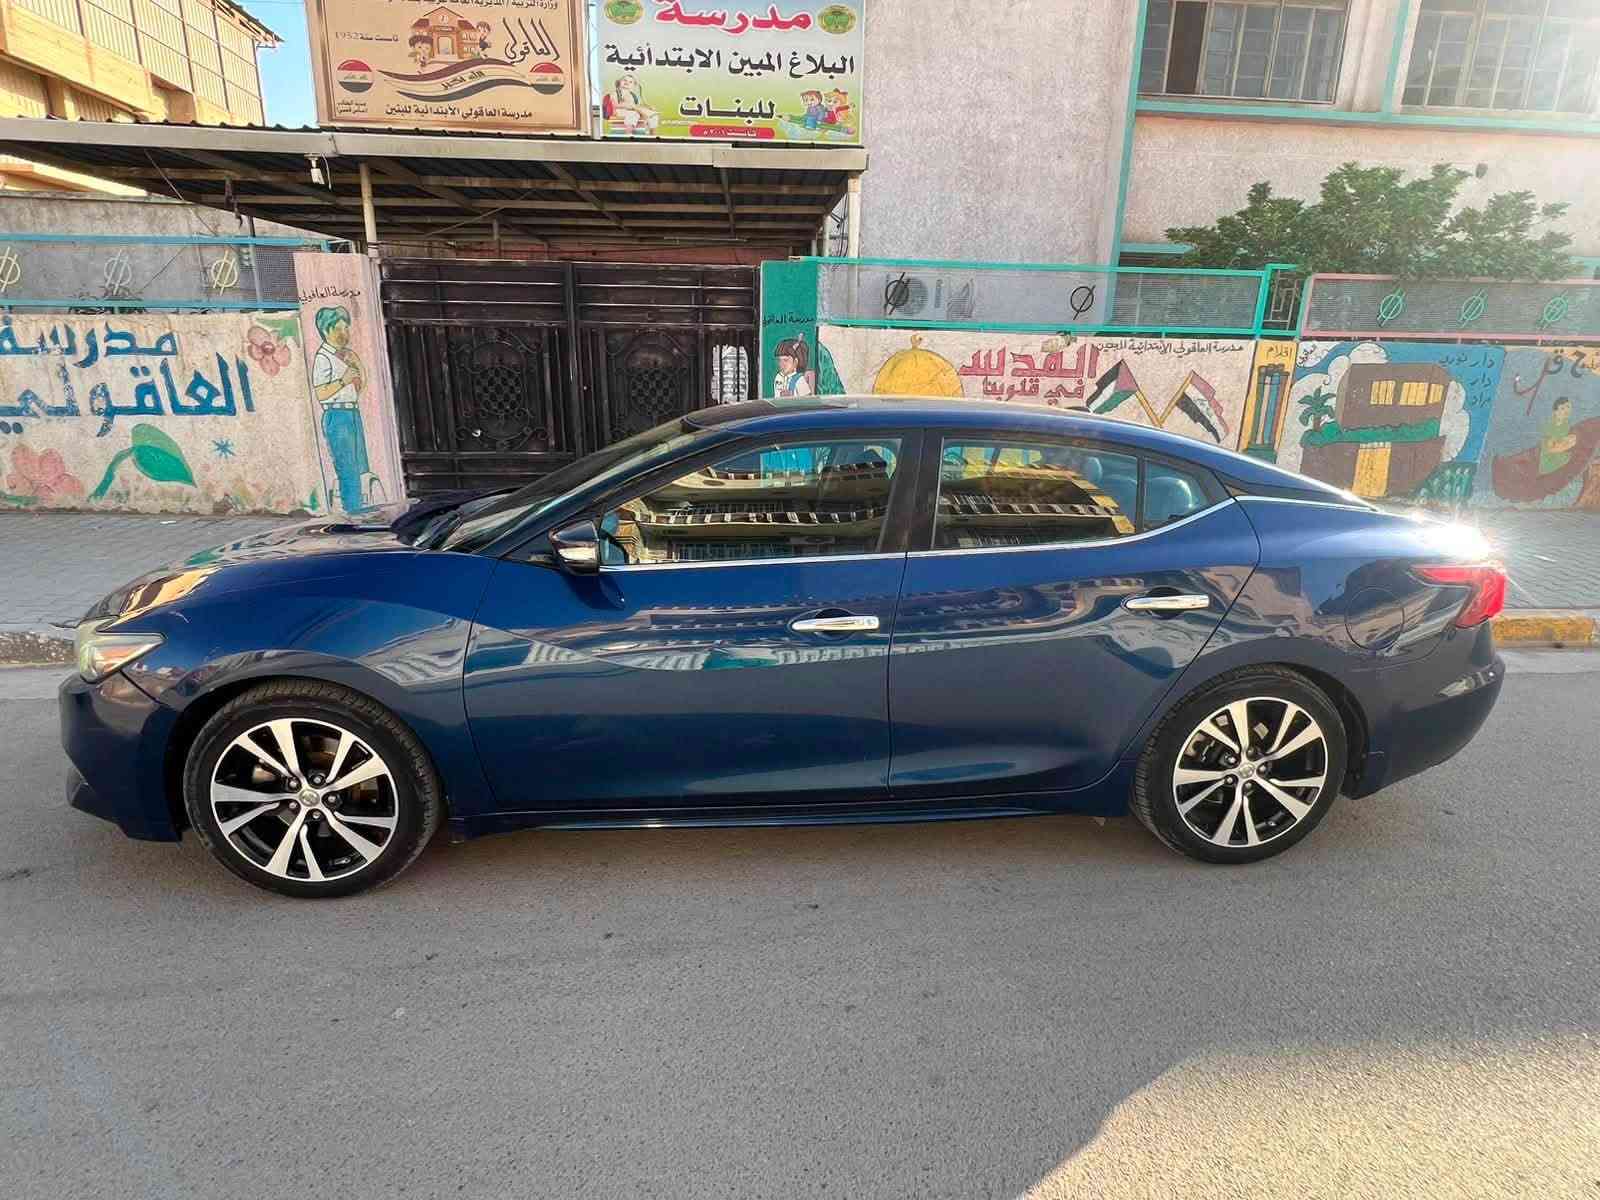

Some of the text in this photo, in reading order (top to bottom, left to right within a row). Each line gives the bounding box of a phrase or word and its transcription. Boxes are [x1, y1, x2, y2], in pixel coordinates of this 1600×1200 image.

[655, 0, 813, 34] مدرسة
[728, 50, 782, 77] المبين
[788, 51, 855, 80] البلاغ
[461, 105, 500, 119] العاقولي
[502, 106, 532, 120] مدرسة
[679, 96, 776, 125] للبنات
[331, 285, 361, 299] مدرسة
[0, 308, 178, 369] مدرسة
[1213, 341, 1244, 352] مدرسة
[1469, 352, 1496, 369] دار
[1469, 371, 1493, 388] دار
[982, 376, 1086, 407] في قلوبنا
